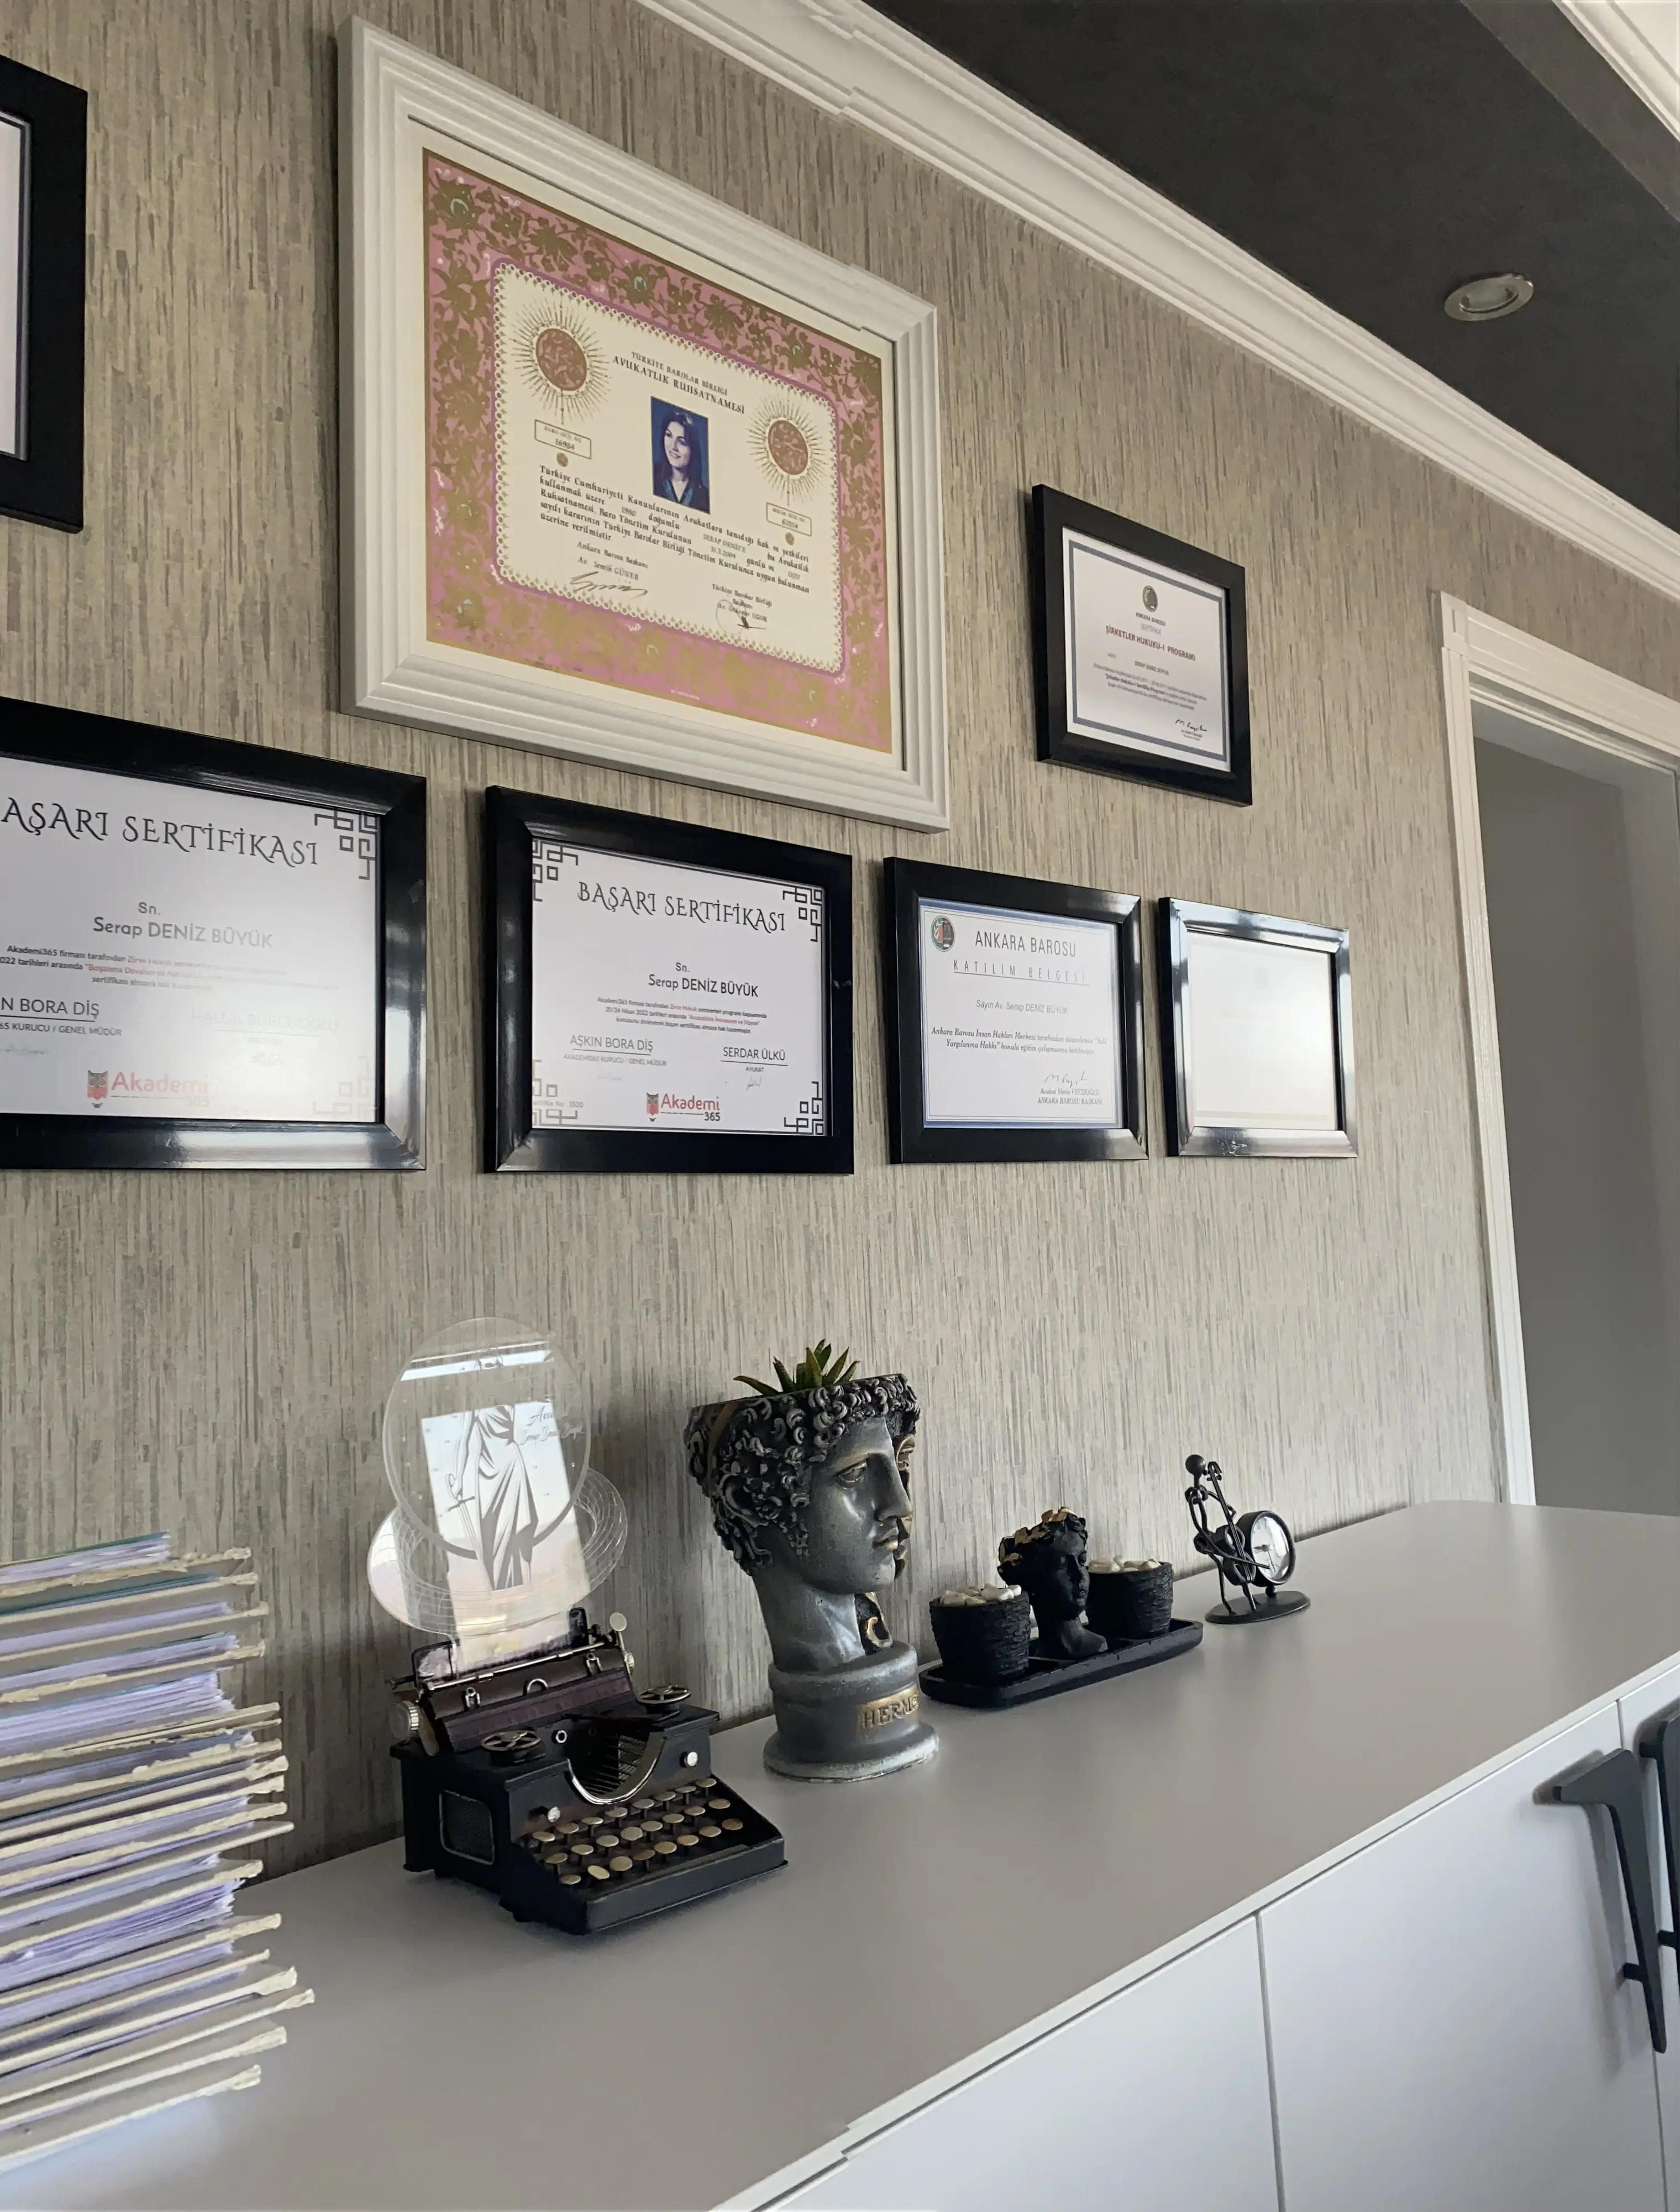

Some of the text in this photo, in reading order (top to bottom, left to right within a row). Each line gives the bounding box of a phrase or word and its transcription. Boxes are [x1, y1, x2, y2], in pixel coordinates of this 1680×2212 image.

[631, 350, 664, 370] TÜRKİYE
[667, 366, 699, 385] BAROLAR
[612, 355, 744, 414] AVUKATLIK RUHSATNAMESİ
[540, 465, 570, 484] Türkiye
[575, 476, 623, 500] Cumhuriyeti
[628, 495, 679, 519] Kanunlarının
[684, 514, 723, 533] Avukatlara
[540, 475, 581, 497] kullanmak
[586, 492, 605, 505] üzere
[621, 506, 637, 517] 1980
[648, 515, 680, 530] doğumlu
[540, 512, 569, 528] üzerine
[599, 507, 616, 520] Baro
[619, 514, 649, 531] Yönetim
[653, 526, 692, 544] Kurulunun
[564, 506, 600, 526] kararının
[603, 520, 631, 538] Türkiye
[634, 531, 660, 545] Barolar
[688, 548, 716, 564] Yönetim
[1106, 625, 1136, 642] ŞİRKETLER
[1167, 646, 1196, 661] PROGRAMI
[123, 816, 318, 868] SERTİFİKASI
[138, 902, 161, 915] Sn.
[578, 882, 785, 933] BAŞARI SERTİFİKASI
[93, 916, 272, 949] Serap DENİZ BÜYÜK
[7, 945, 57, 956] Akademi365
[975, 931, 1076, 957] ANKARA BAROSU
[675, 962, 690, 972] Sn.
[954, 959, 1015, 976] KATILIM
[648, 974, 758, 997] Serap DENİZ BÜYÜK
[20, 998, 68, 1015] BORA
[74, 1000, 99, 1019] DİŞ
[977, 999, 994, 1010] Sayın
[1006, 1002, 1024, 1012] Serap
[12, 1024, 50, 1032] KURUCU
[59, 1026, 86, 1034] GENEL
[931, 1026, 953, 1035] Ankara
[955, 1028, 974, 1037] Barosu
[1015, 1031, 1036, 1040] Merkezi
[570, 1035, 653, 1053] AŞKIN BORA DİŞ
[723, 1047, 785, 1061] SERDAR ÜLKÜ
[111, 1071, 208, 1094] Akademi
[660, 1093, 720, 1111] Akademi
[704, 1112, 720, 1121] 365
